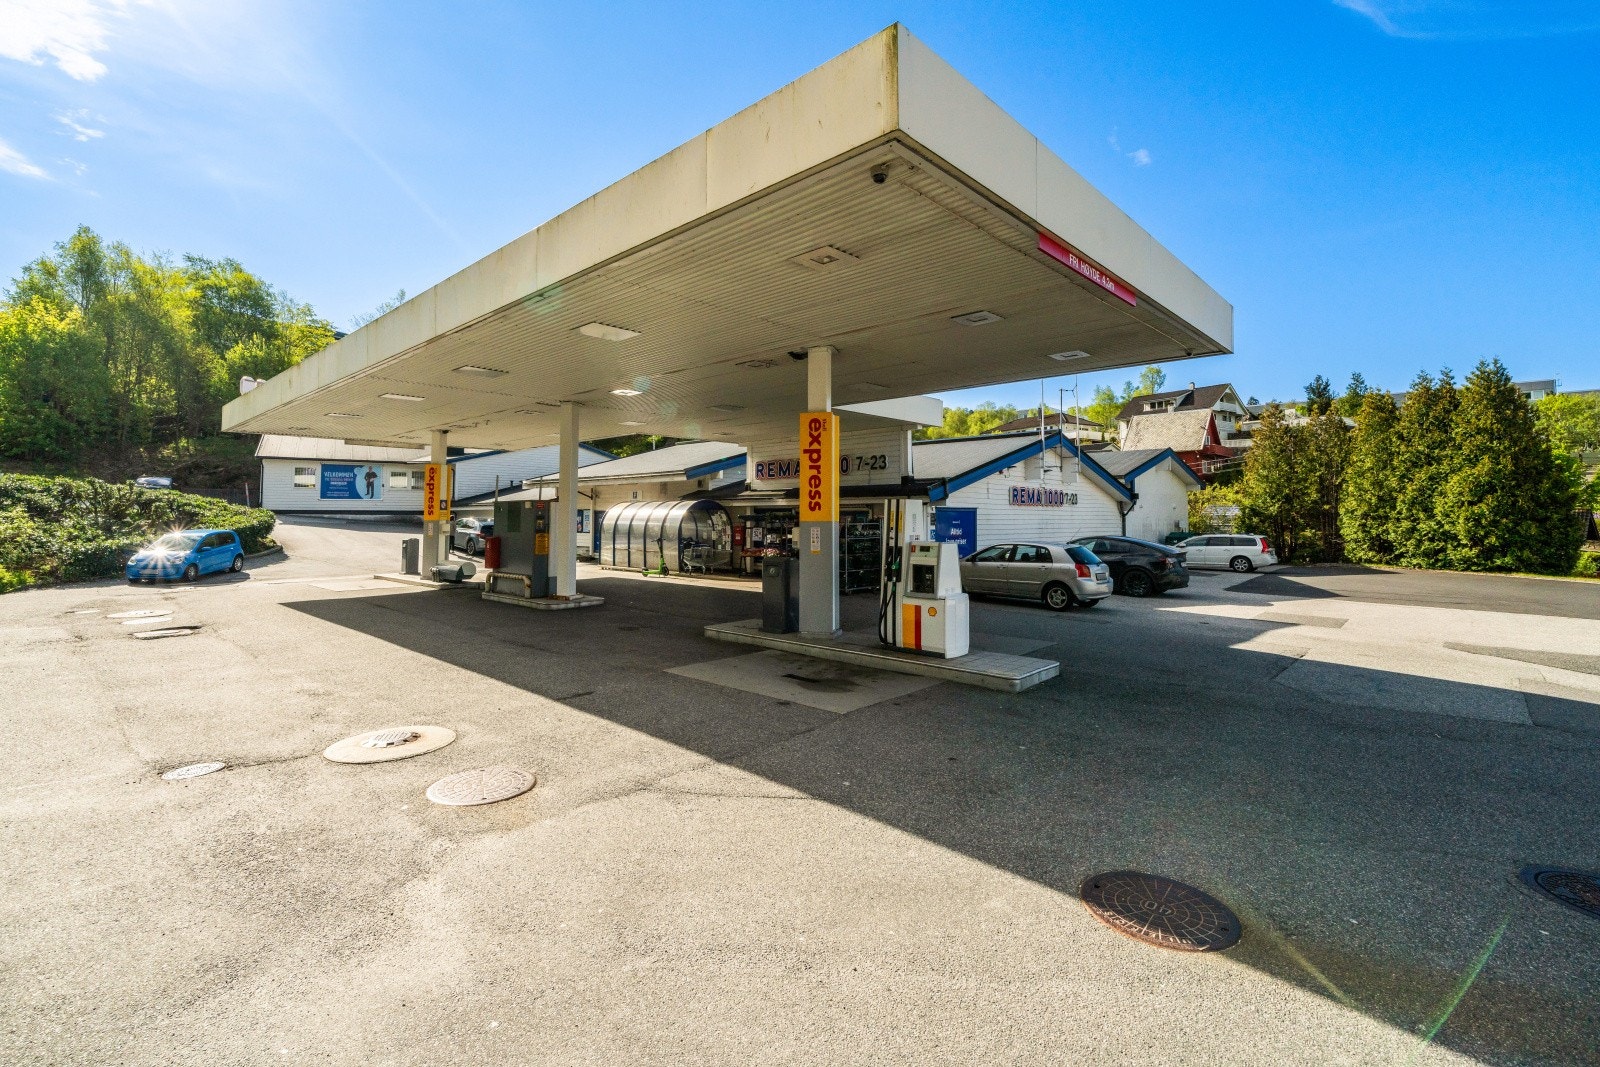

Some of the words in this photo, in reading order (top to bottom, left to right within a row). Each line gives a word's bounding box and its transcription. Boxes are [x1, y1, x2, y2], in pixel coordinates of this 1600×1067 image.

[1069, 253, 1079, 268] FRI
[1080, 261, 1101, 282] HØYDE
[803, 417, 822, 512] express
[855, 454, 888, 471] 7-23
[426, 467, 435, 516] express
[1012, 485, 1041, 506] REMA
[1043, 488, 1065, 507] 1000
